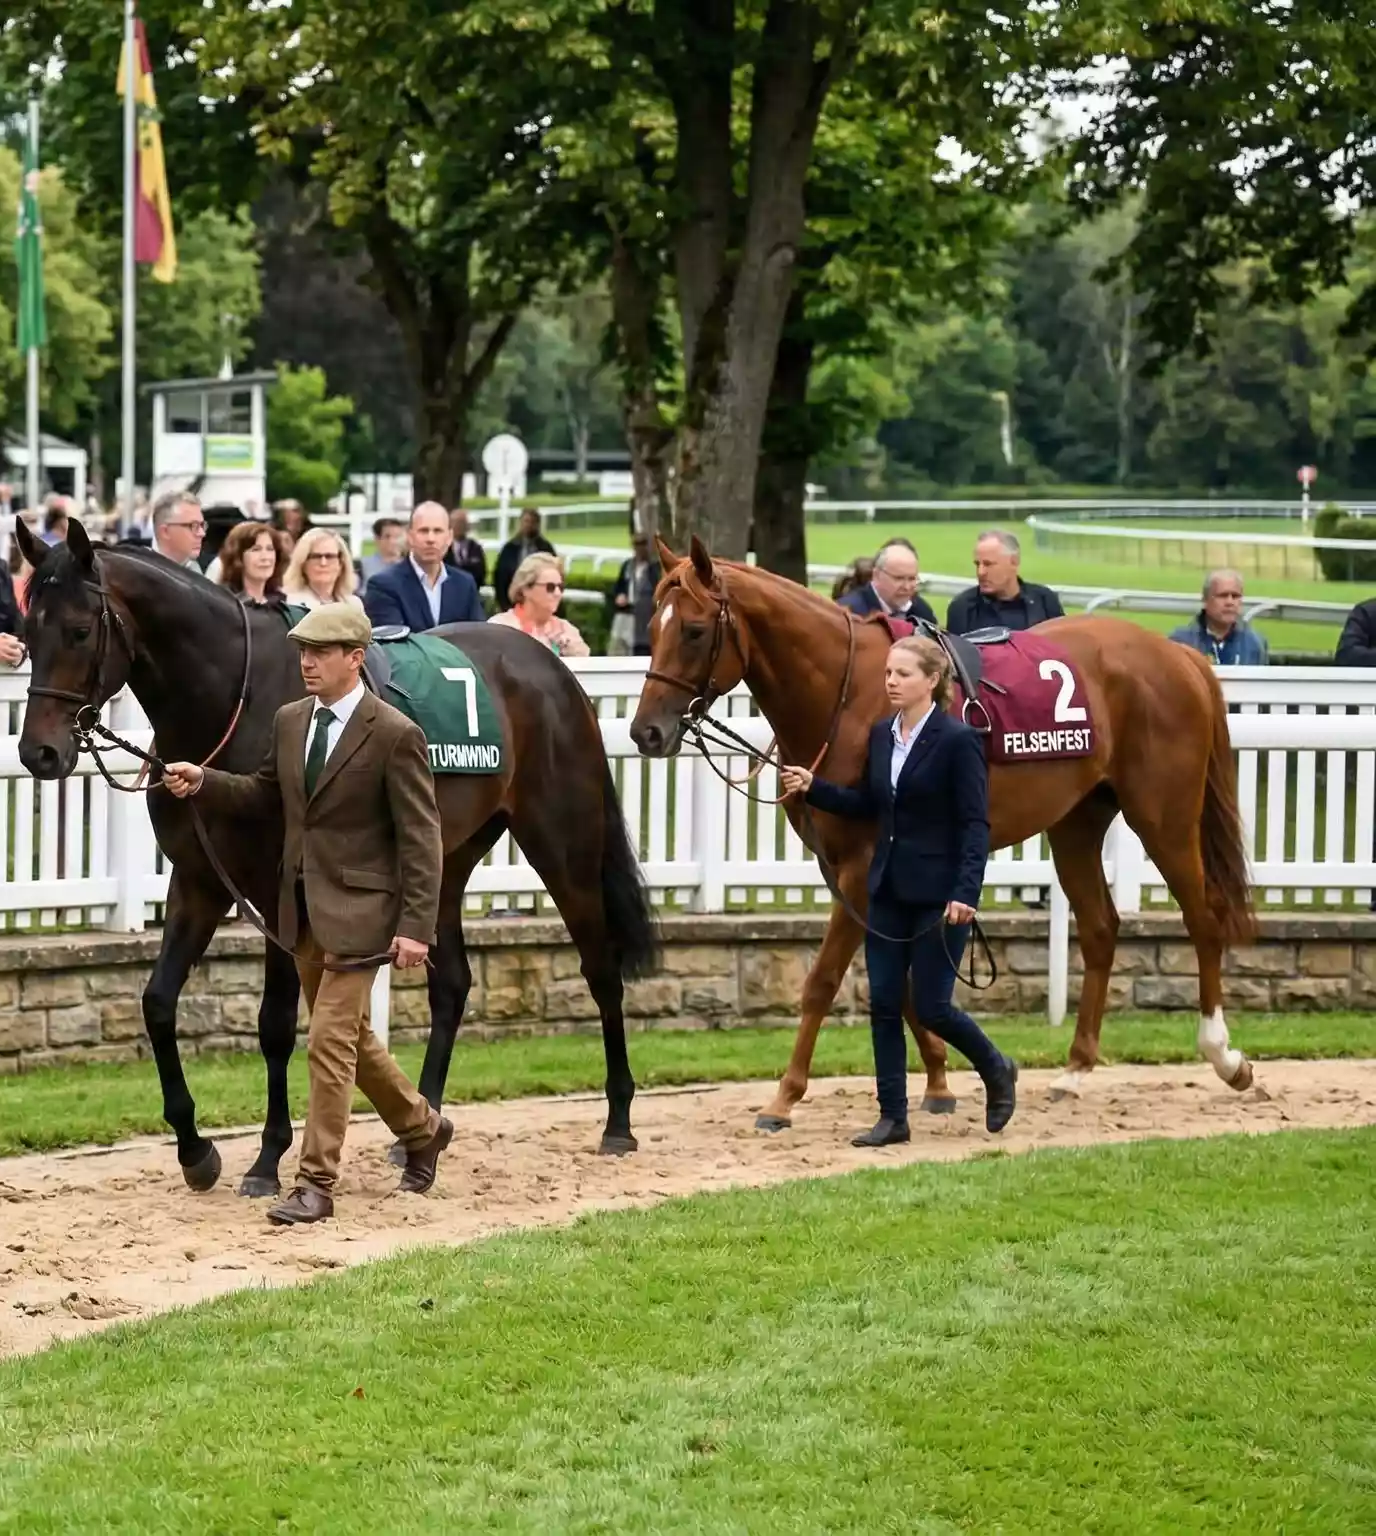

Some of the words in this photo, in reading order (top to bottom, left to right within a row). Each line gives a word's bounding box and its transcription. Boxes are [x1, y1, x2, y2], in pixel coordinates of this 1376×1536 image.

[440, 667, 479, 737] 7
[1039, 659, 1087, 723] 2
[427, 744, 500, 768] TURMWIND
[1004, 729, 1091, 754] FELSENFEST
